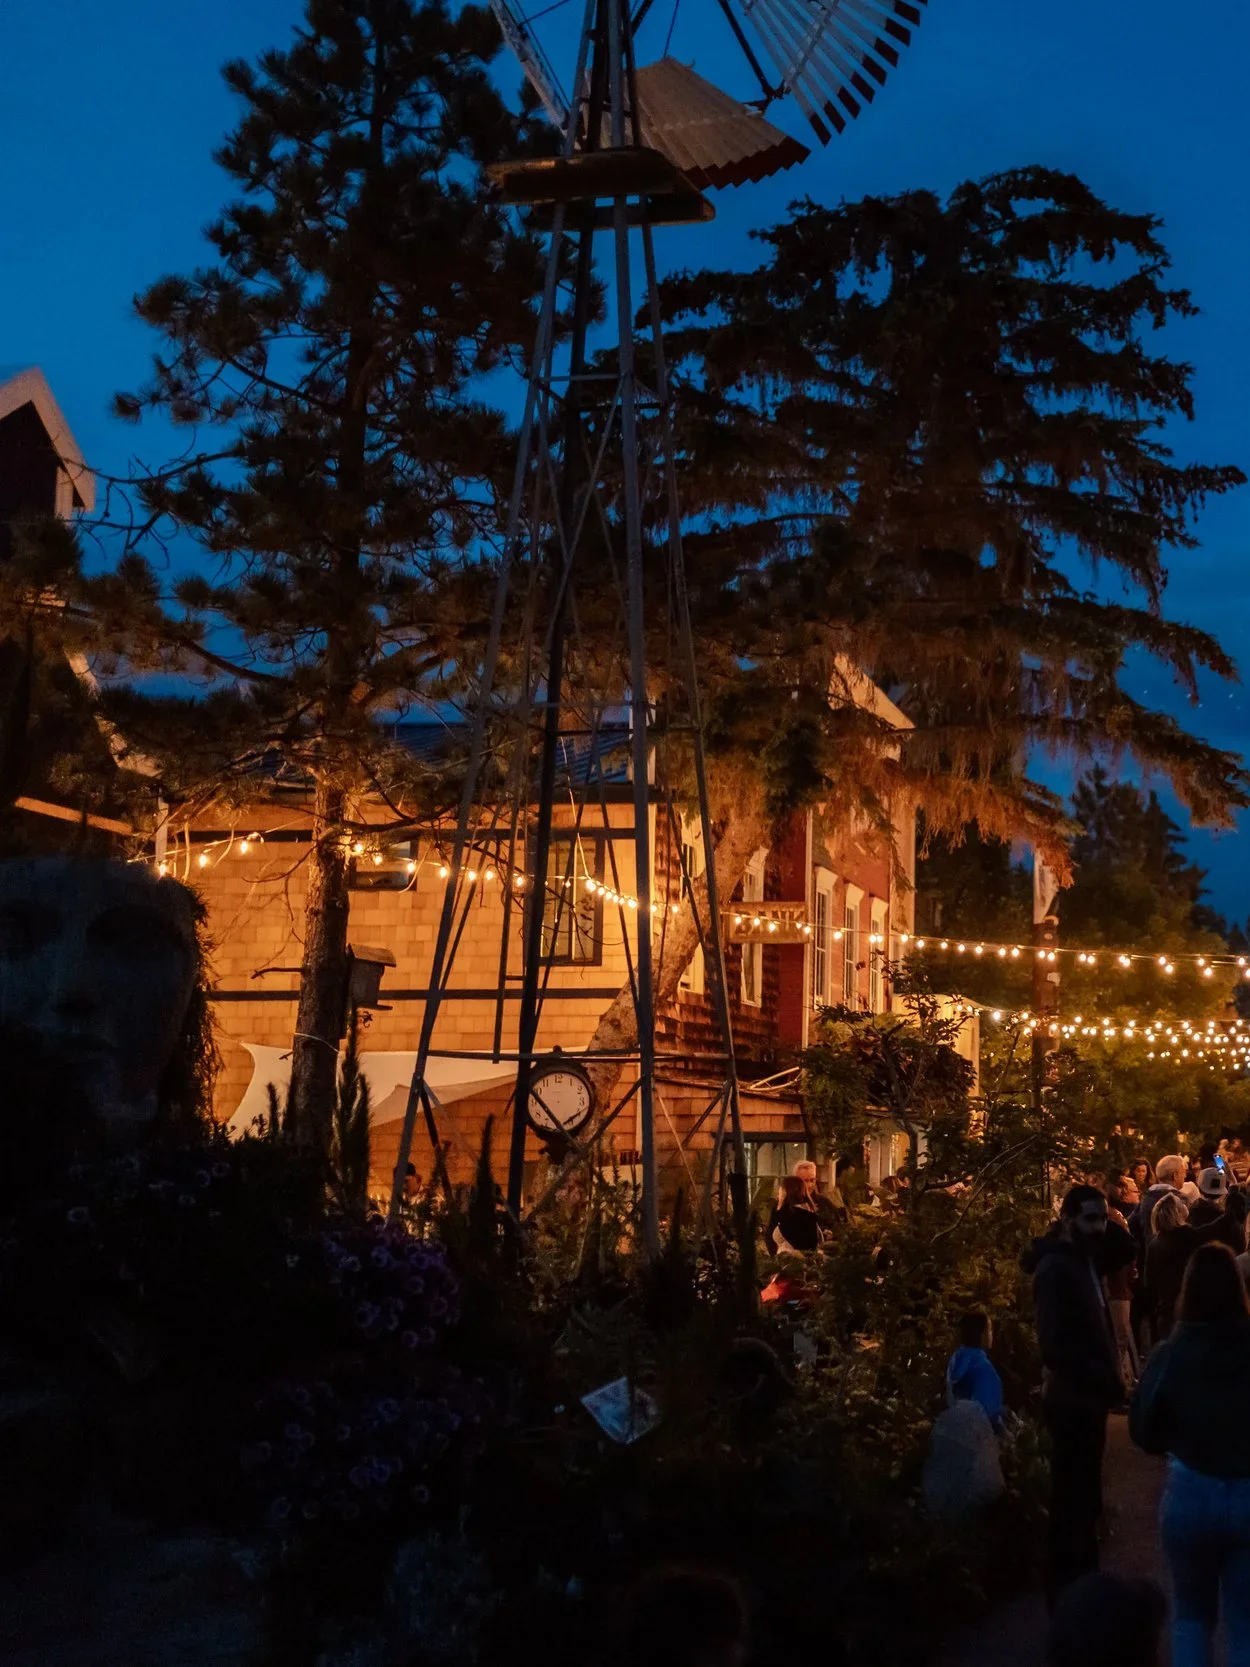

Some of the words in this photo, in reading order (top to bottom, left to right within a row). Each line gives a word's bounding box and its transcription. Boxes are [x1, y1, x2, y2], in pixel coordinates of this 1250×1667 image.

[734, 910, 806, 937] BANK
[542, 1079, 549, 1087] 11
[554, 1075, 563, 1084] 12
[569, 1079, 573, 1087] 1
[577, 1086, 583, 1095] 2
[579, 1097, 585, 1106] 3
[535, 1111, 541, 1119] 8
